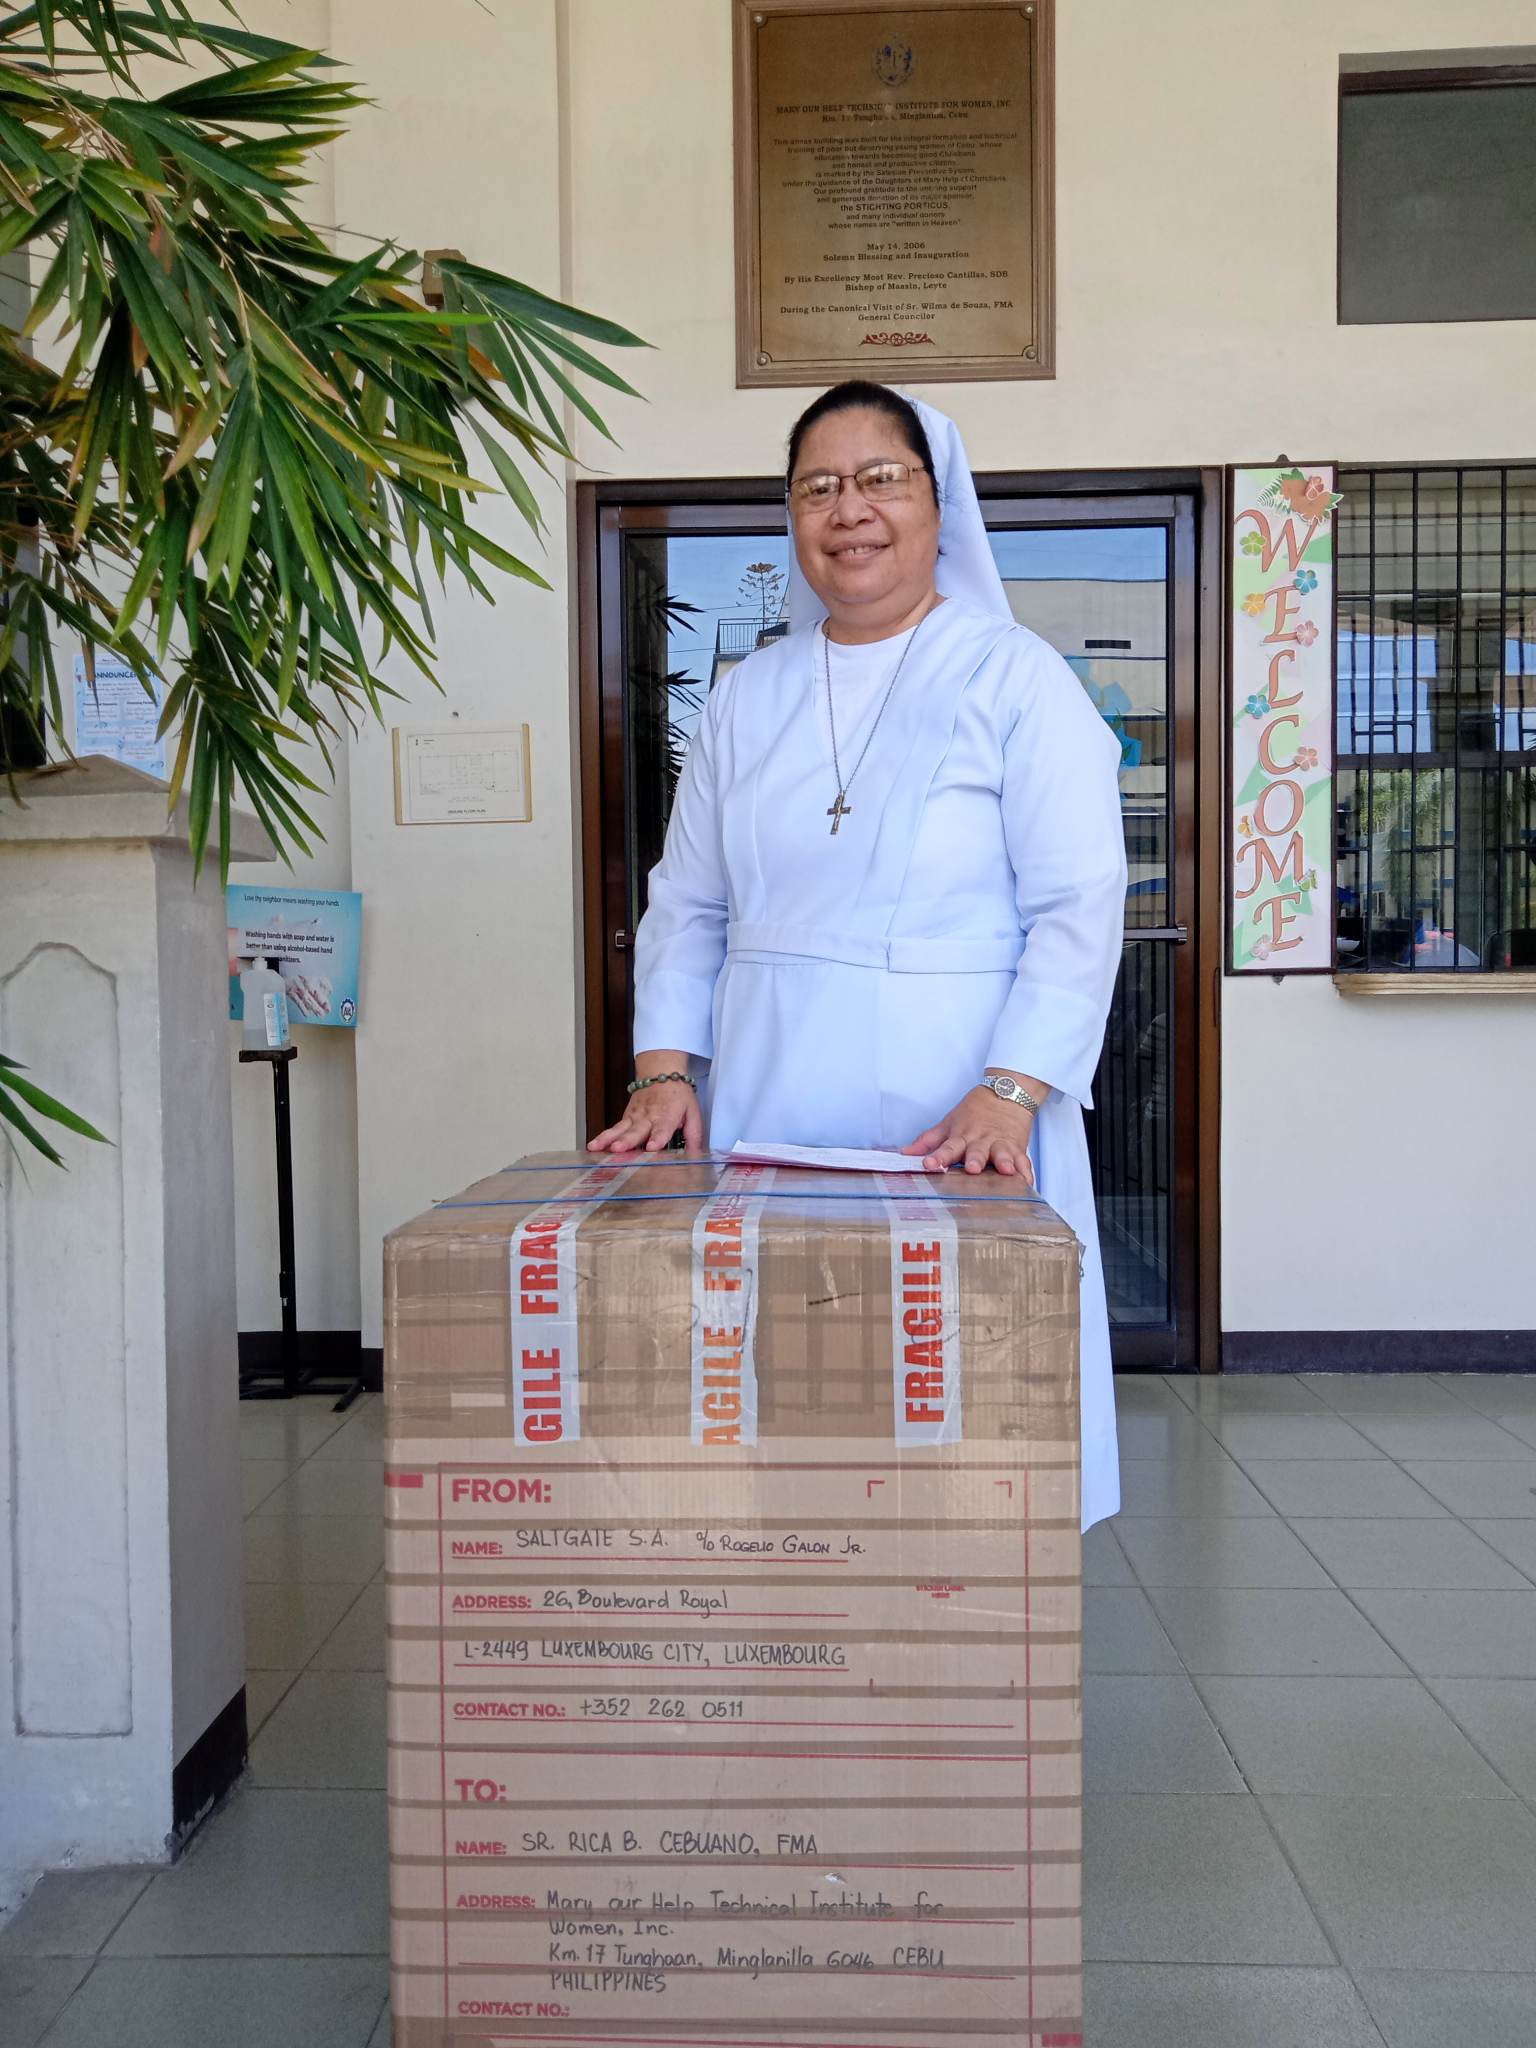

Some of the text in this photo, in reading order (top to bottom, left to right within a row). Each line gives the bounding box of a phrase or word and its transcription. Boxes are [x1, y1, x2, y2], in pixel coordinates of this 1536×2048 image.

[856, 203, 901, 212] STICHTING
[867, 243, 884, 251] May
[823, 254, 855, 262] Solemn
[858, 253, 893, 261] Blessing
[914, 251, 969, 260] Inauguration
[814, 274, 860, 283] Excellency
[846, 284, 874, 292] Bishop
[924, 282, 947, 290] Leyte
[780, 305, 809, 314] During
[828, 304, 870, 312] Canonical
[873, 303, 893, 311] Visit
[920, 302, 947, 310] Wilma
[994, 300, 1014, 308] FMA
[858, 312, 936, 321] General Councilor
[1234, 507, 1319, 952] WELCOME
[263, 896, 282, 904] neighbor
[298, 898, 315, 906] washing
[246, 930, 266, 939] Washing
[274, 944, 286, 952] using
[288, 945, 320, 953] alcohol-based
[902, 1240, 945, 1423] FRAGILE
[703, 1325, 743, 1446] AGILE
[522, 1348, 563, 1442] GILE
[452, 1478, 552, 1503] FROM:
[516, 1528, 613, 1548] SALTGATE
[452, 1542, 502, 1554] NAME:
[452, 1594, 532, 1608] ADDRESS:
[577, 1588, 670, 1609] Boulevard
[680, 1589, 728, 1618] Royal
[464, 1640, 846, 1668] L-2449 LUXEMBOURG CITY, LUXEMBOURG
[454, 1702, 566, 1718] CONTACT NO.:
[580, 1698, 744, 1718] +352 262 0511
[454, 1779, 506, 1803] TO:
[455, 1841, 507, 1856] NAME:
[522, 1831, 554, 1852] SR.
[568, 1831, 612, 1853] RICA
[623, 1830, 642, 1851] B.
[777, 1834, 818, 1855] FMA
[456, 1894, 536, 1909] ADDRESS:
[547, 1890, 593, 1919] Mary
[652, 1891, 694, 1921] Help
[710, 1890, 796, 1916] Technical
[810, 1890, 895, 1917] Institute
[914, 1891, 944, 1918] for
[634, 1920, 674, 1936] Inc.
[550, 1942, 581, 1962] Km.
[586, 1944, 606, 1964] 17
[717, 1946, 814, 1980] Minglanilla
[893, 1947, 944, 1969] CEBU
[551, 1971, 667, 1993] PHILIPPINES
[458, 2001, 570, 2017] CONTACT NO.:
